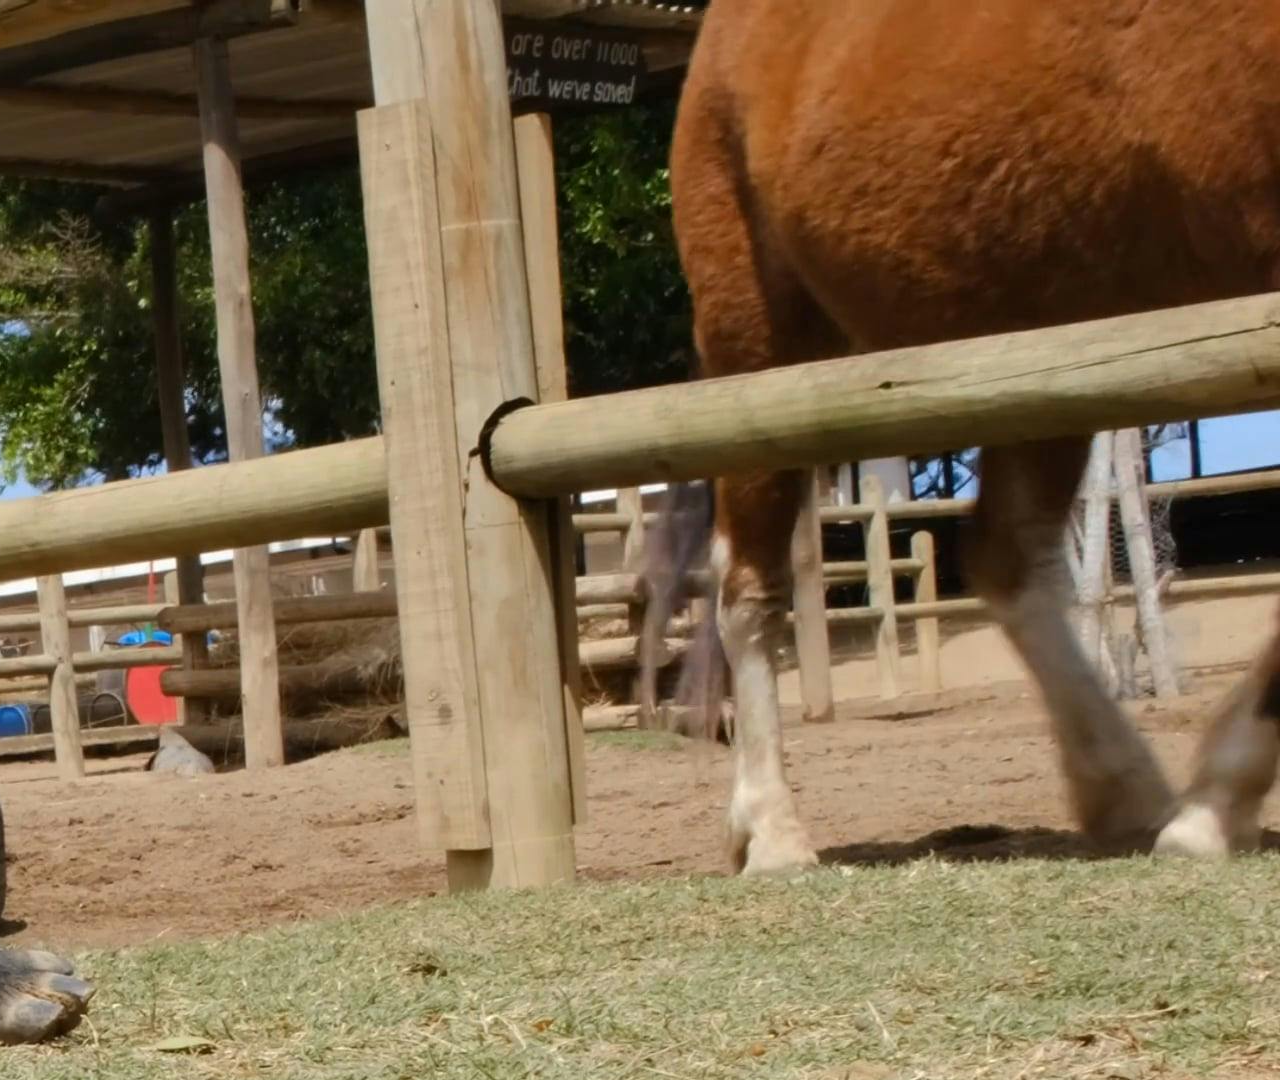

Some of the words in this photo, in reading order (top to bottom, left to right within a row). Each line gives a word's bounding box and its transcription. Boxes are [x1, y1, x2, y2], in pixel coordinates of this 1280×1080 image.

[511, 33, 544, 57] are
[552, 37, 591, 61] over
[507, 68, 541, 97] that
[593, 75, 636, 104] saved
